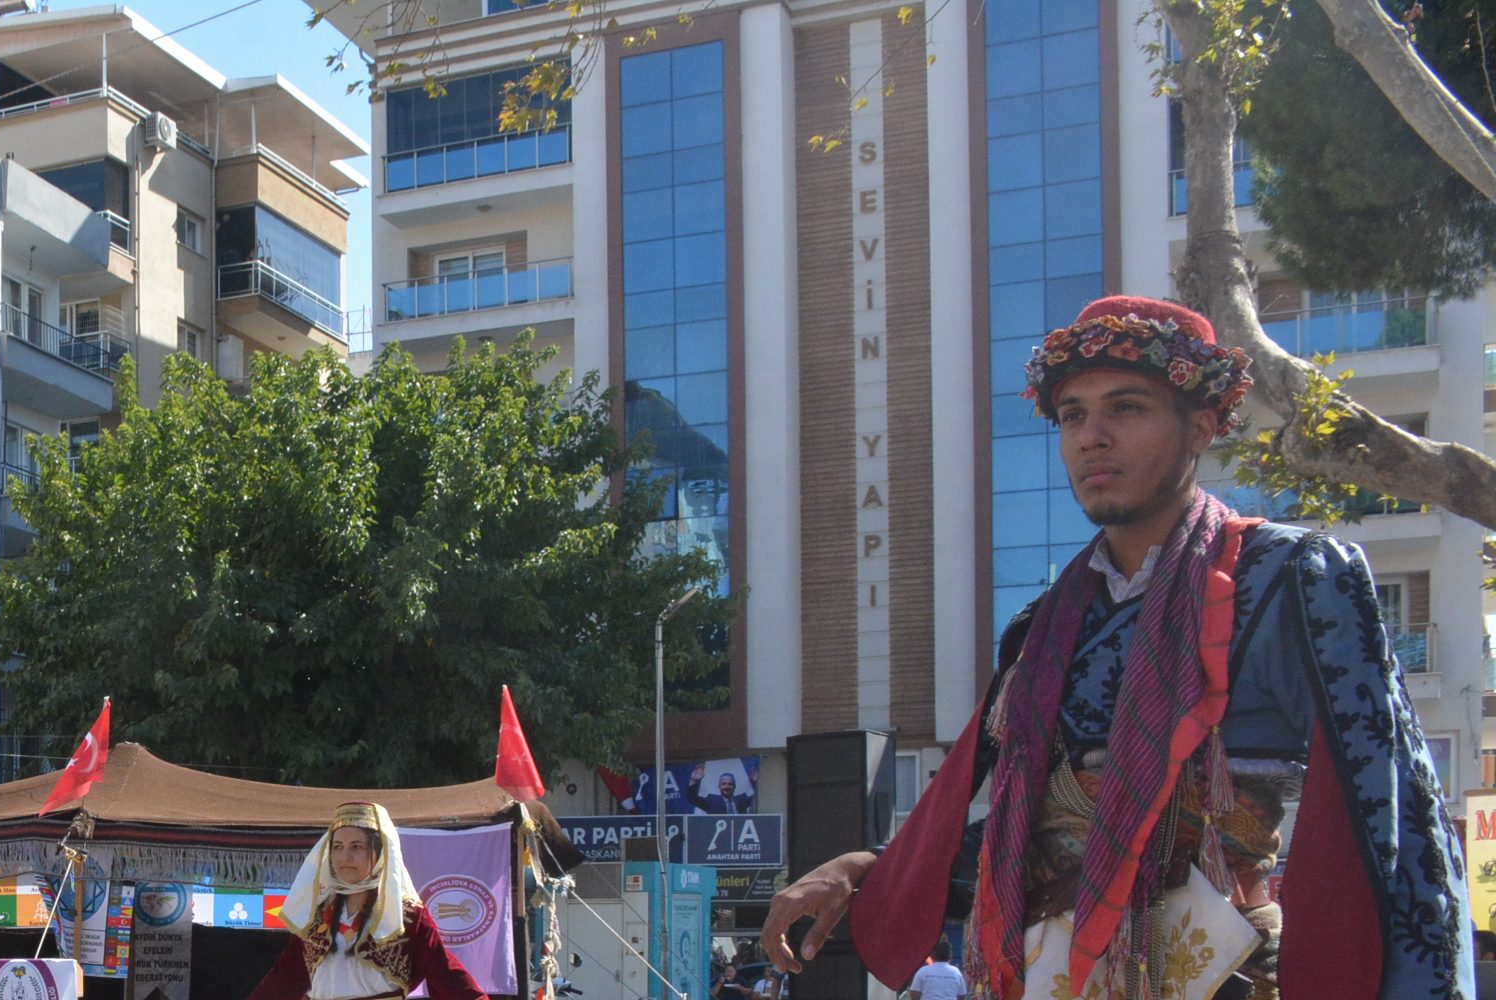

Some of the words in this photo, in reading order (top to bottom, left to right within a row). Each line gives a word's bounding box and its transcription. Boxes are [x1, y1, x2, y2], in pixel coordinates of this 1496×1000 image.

[859, 141, 881, 360] SEVİN
[861, 435, 883, 607] YAPI
[737, 843, 761, 851] PARTİ
[738, 819, 760, 843] A
